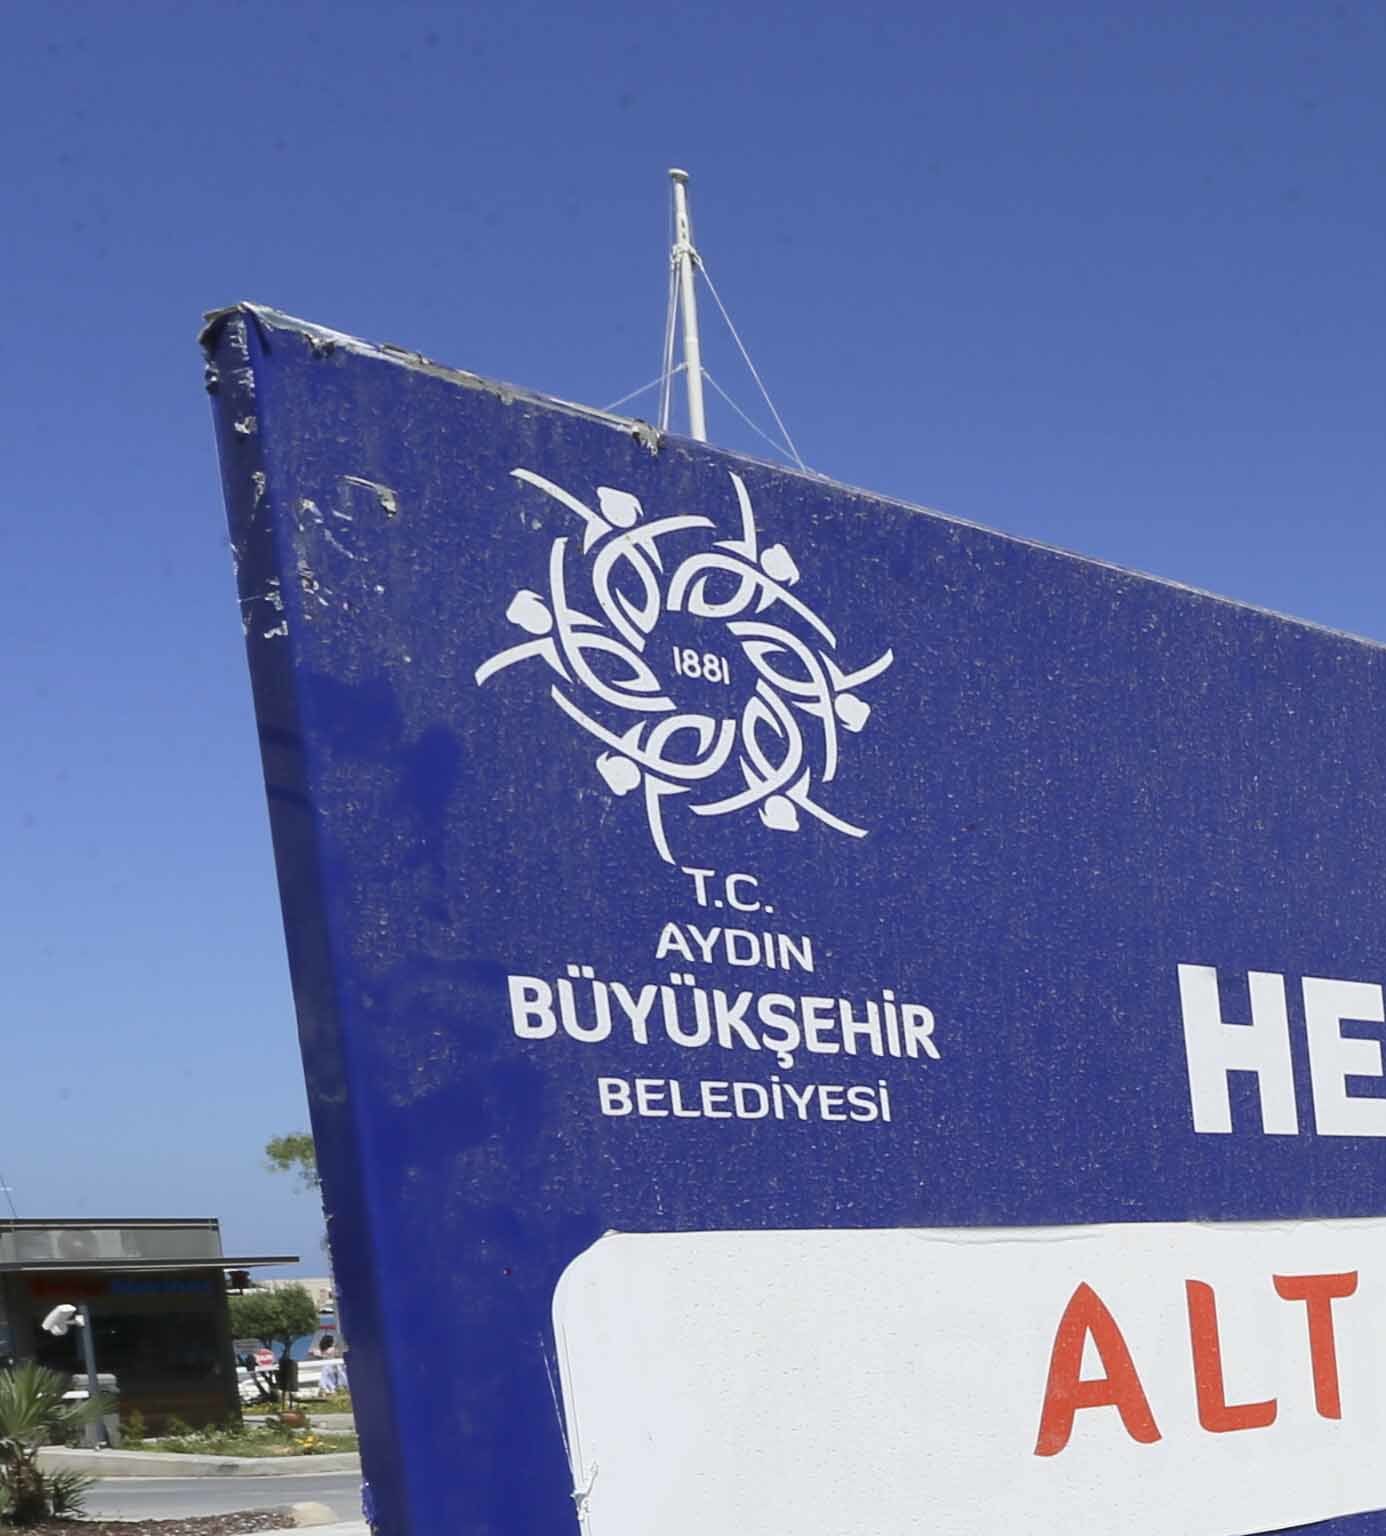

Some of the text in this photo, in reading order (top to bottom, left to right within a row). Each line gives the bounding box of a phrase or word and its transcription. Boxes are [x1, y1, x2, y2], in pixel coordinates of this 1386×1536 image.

[673, 646, 730, 685] 1881
[682, 867, 775, 912] T.C.
[656, 923, 813, 972] AYDIN
[507, 965, 941, 1069] BÜYÜKŞEHİR
[598, 1075, 891, 1123] BELEDİYESİ
[1034, 1271, 1358, 1457] ALT
